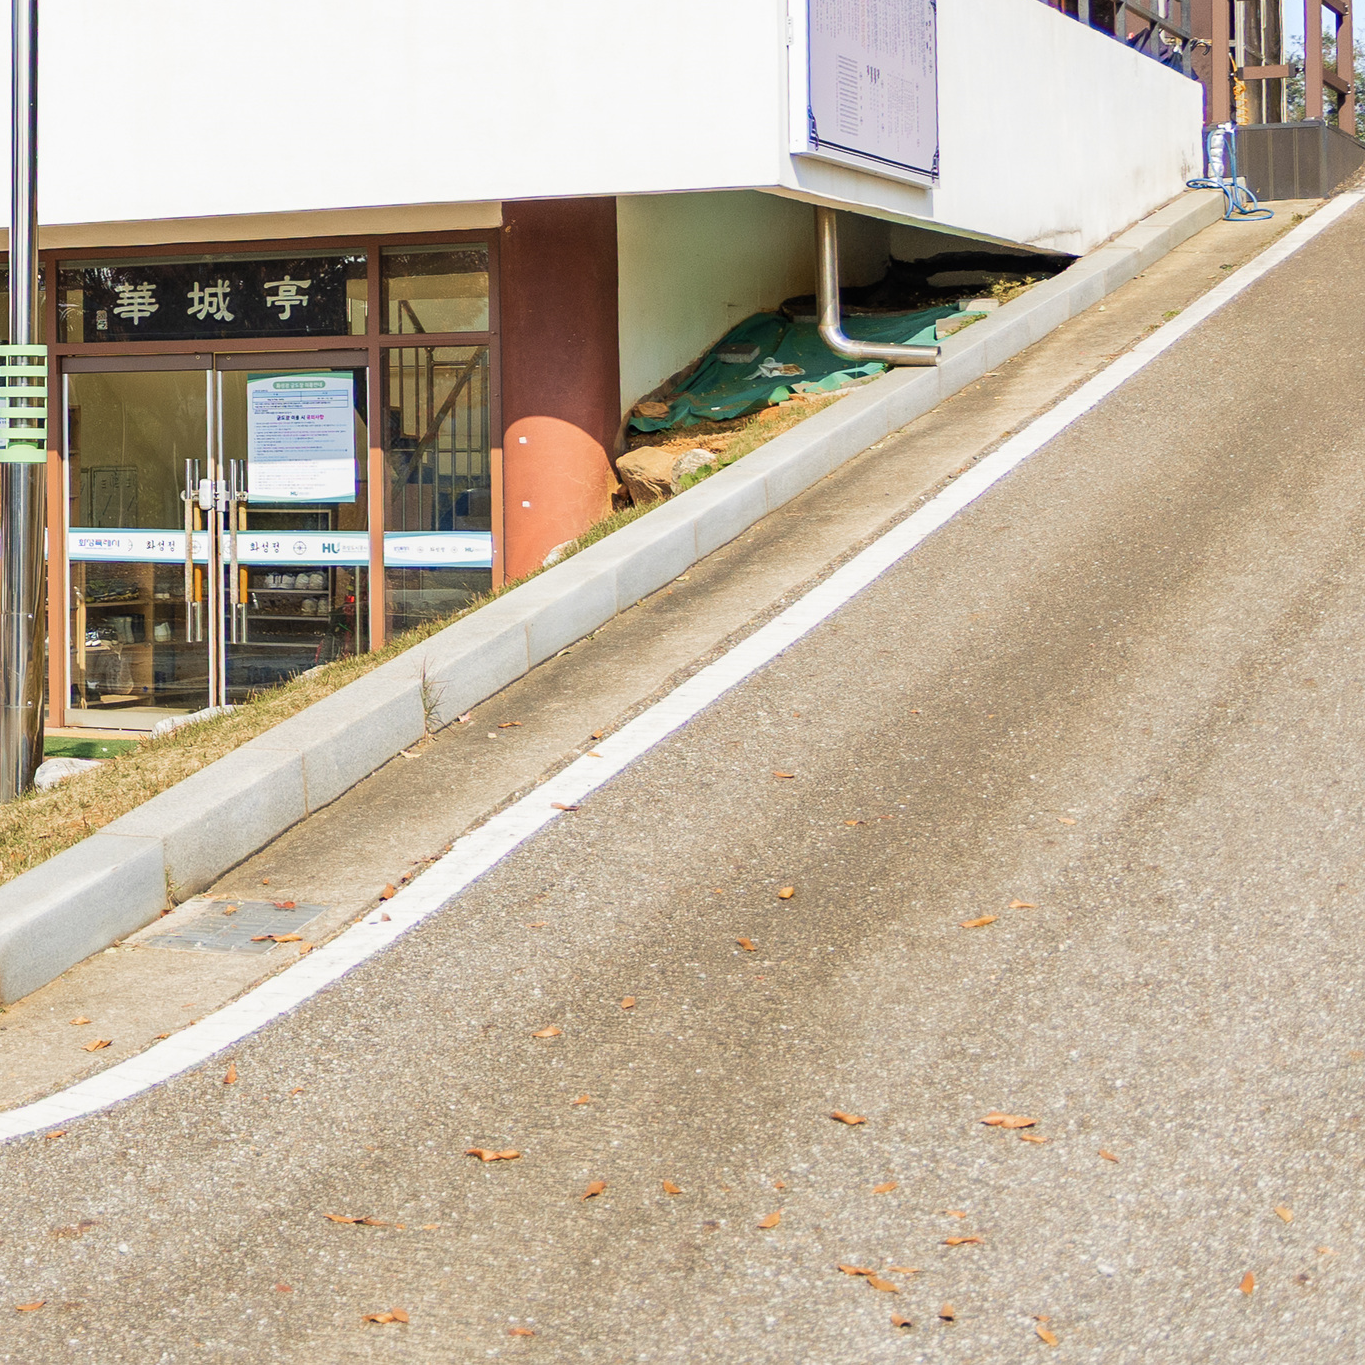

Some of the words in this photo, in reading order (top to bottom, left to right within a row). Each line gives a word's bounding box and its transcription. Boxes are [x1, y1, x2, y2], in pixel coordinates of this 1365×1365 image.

[113, 275, 312, 326] 華城亭
[146, 540, 176, 552] 화성정
[250, 541, 280, 554] 화성정
